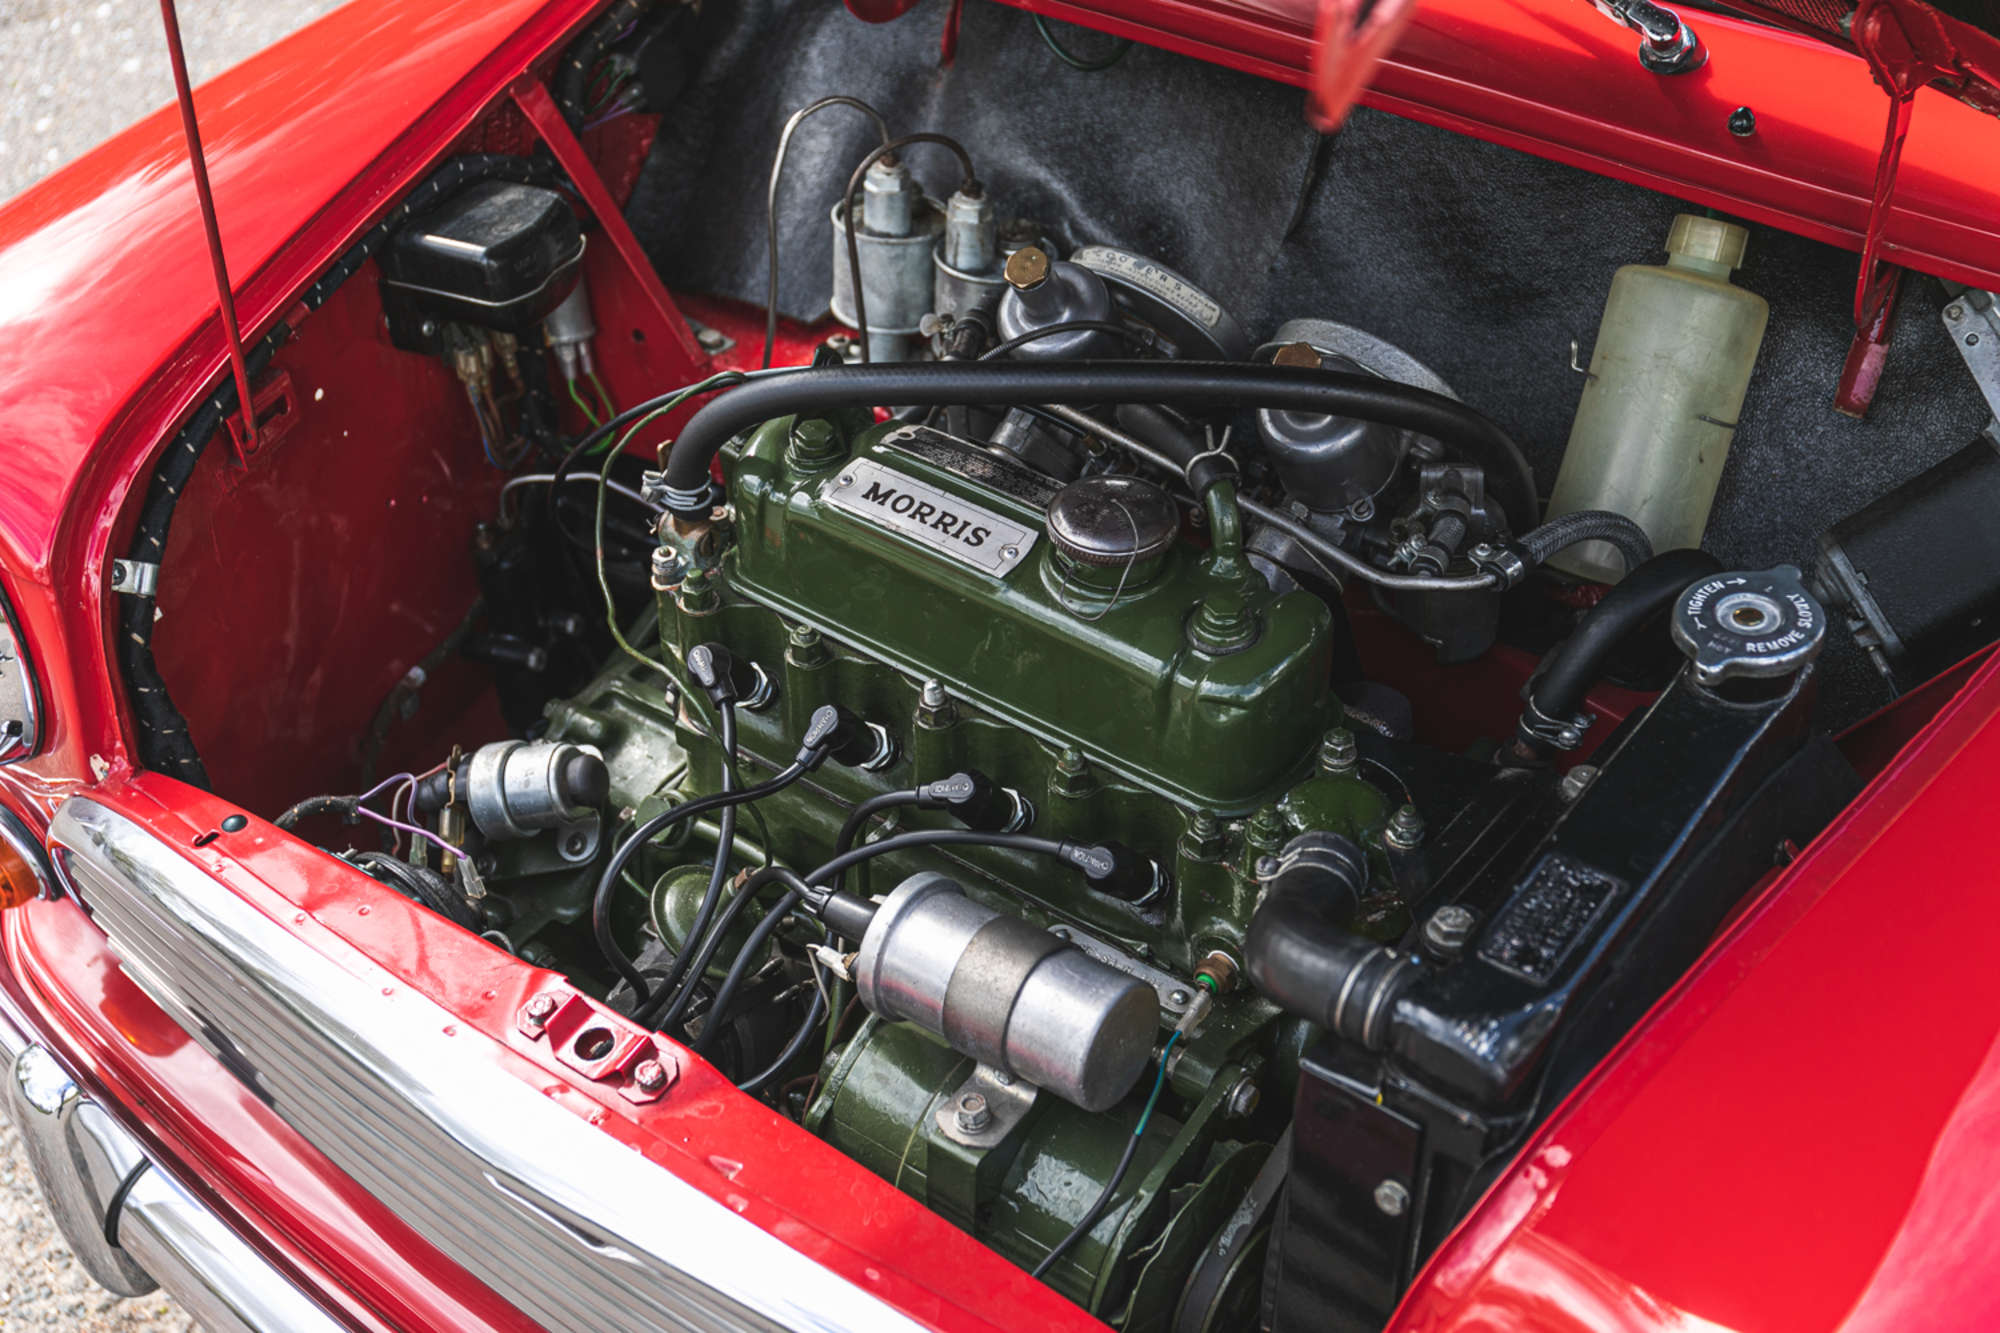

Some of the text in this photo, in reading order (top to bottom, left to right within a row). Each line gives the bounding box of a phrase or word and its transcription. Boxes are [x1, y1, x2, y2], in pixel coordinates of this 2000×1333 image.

[861, 481, 992, 547] MORRIS
[1687, 580, 1726, 617] TIGHTEN
[1745, 592, 1813, 653] REMOVE SLOWLY
